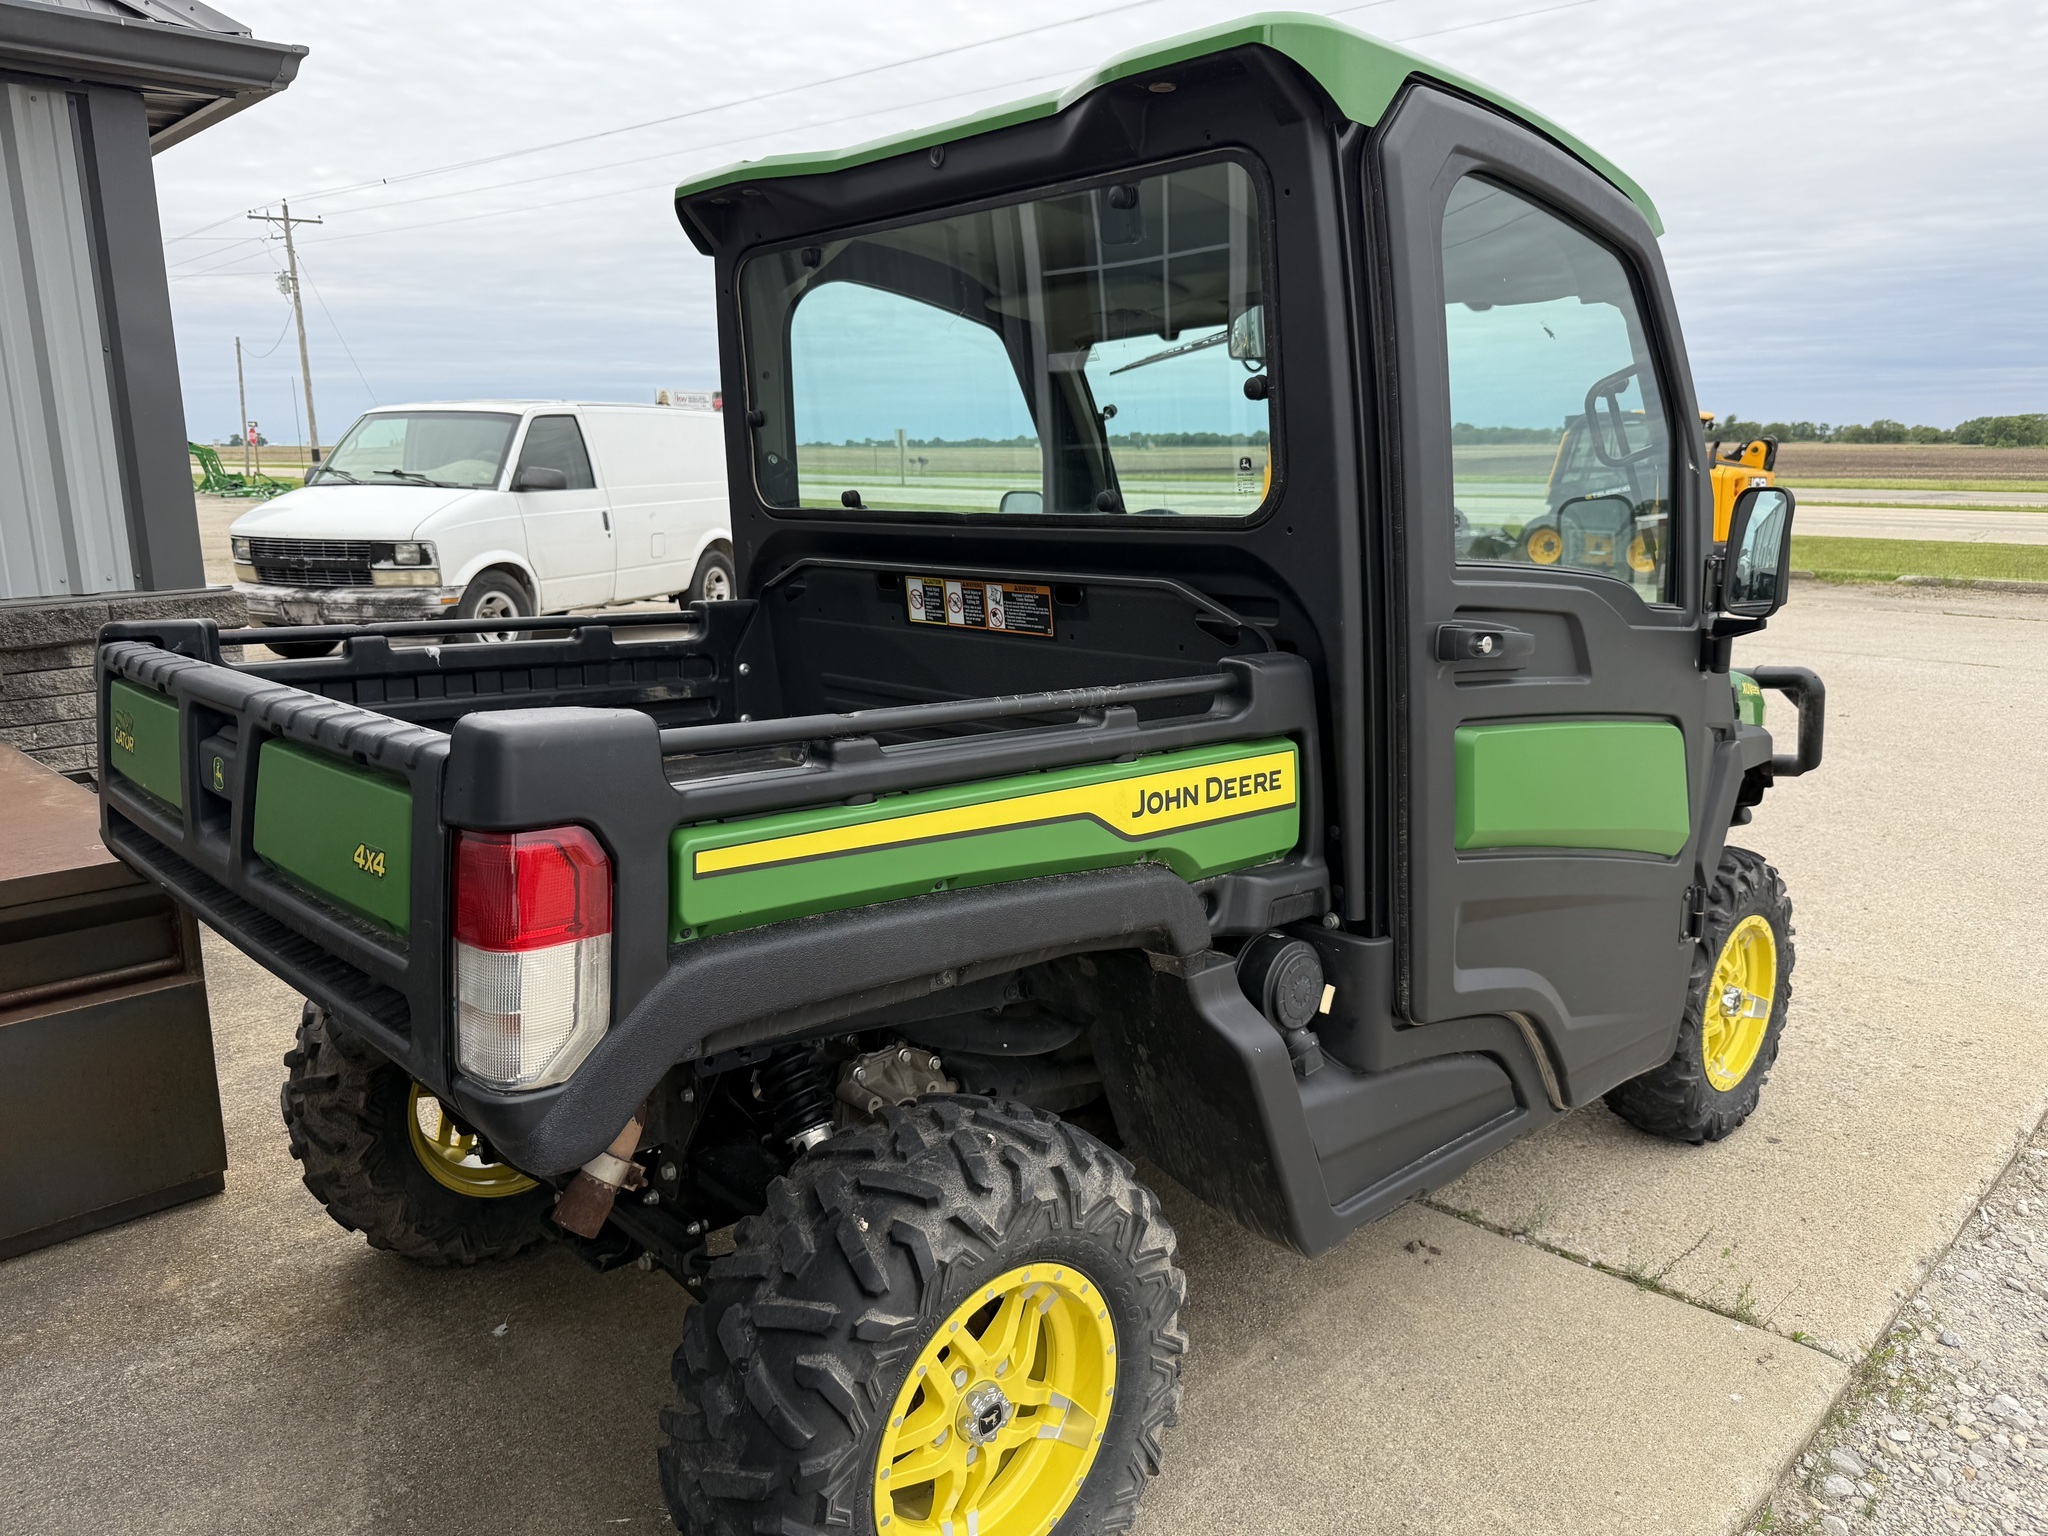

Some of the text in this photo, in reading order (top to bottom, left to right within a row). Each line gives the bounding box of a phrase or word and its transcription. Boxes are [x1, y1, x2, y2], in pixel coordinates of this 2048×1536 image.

[114, 726, 134, 753] GATOR
[1131, 769, 1282, 819] JOHN DEERE
